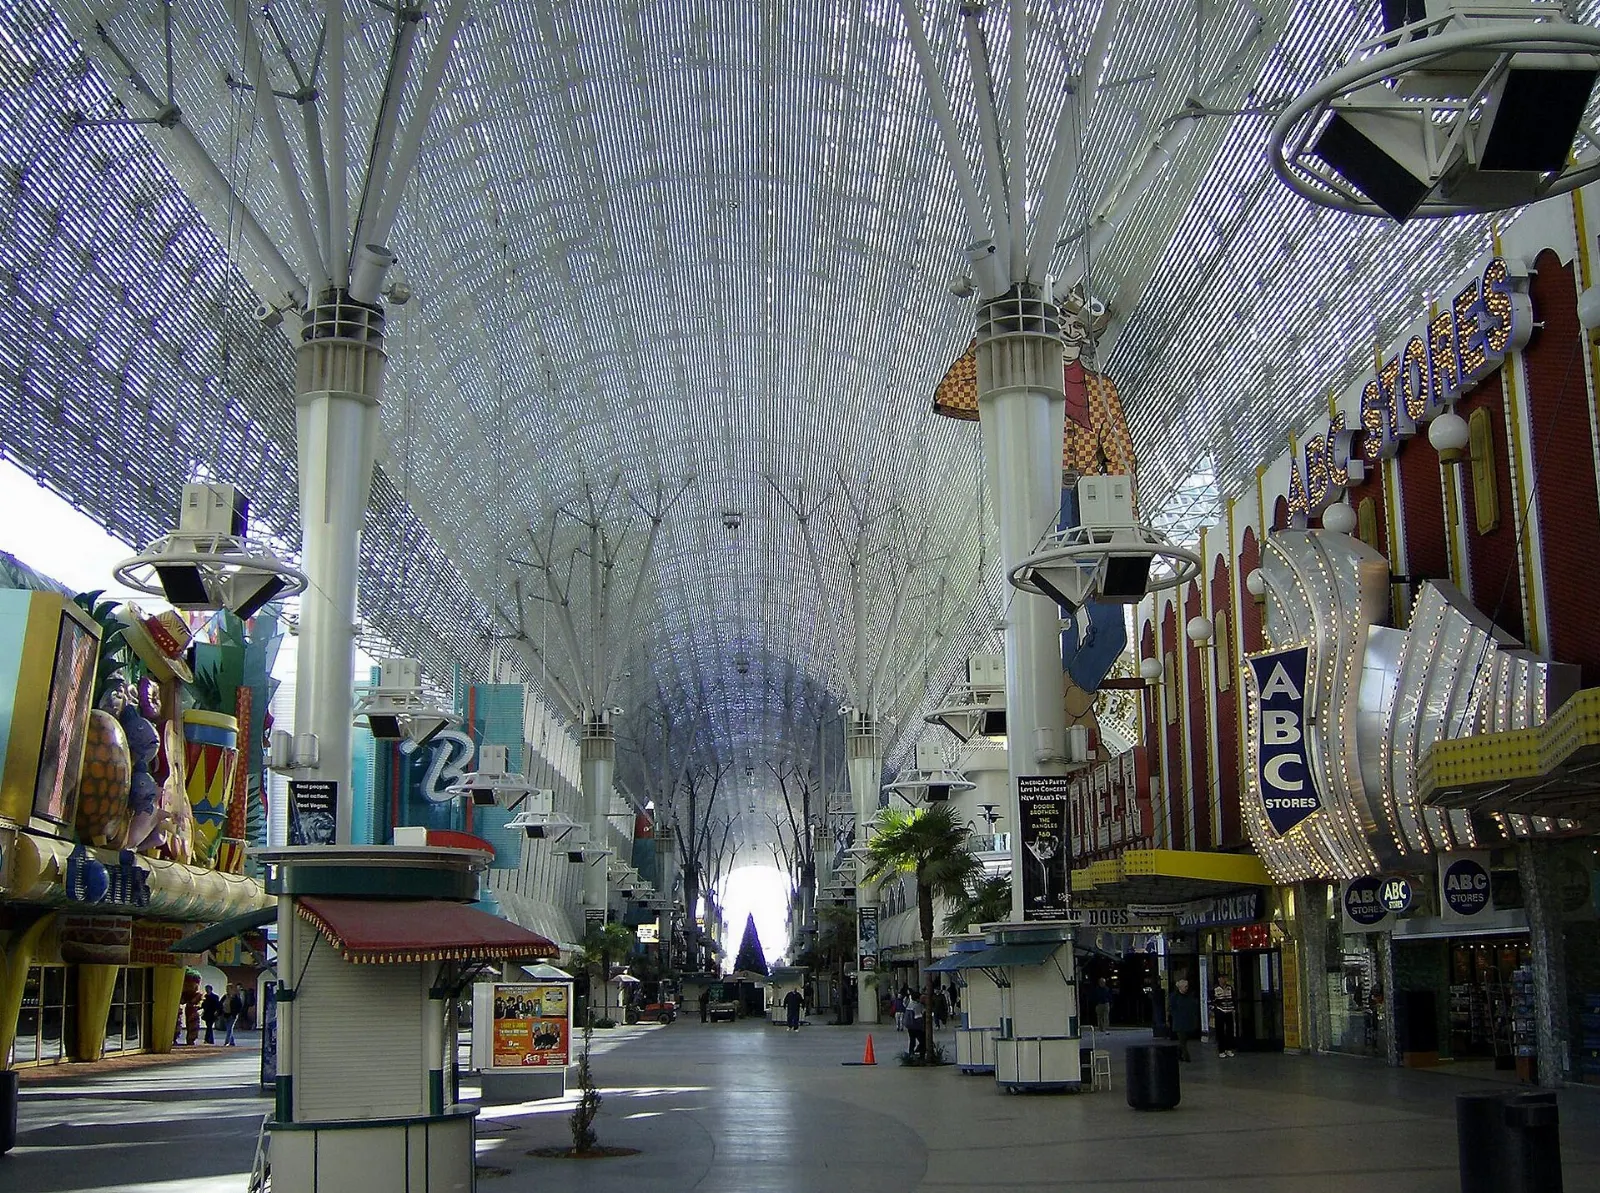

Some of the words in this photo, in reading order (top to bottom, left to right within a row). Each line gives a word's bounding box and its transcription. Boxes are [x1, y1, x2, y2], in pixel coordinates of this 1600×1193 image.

[1286, 409, 1350, 529] ABC
[1360, 256, 1513, 459] STORES
[1260, 660, 1304, 791] ABC
[1265, 798, 1317, 809] STORES
[1446, 873, 1487, 890] ABC
[1384, 880, 1407, 901] ABC
[1450, 892, 1484, 903] STORES
[1212, 893, 1257, 922] TICKETS
[1352, 906, 1385, 915] STORES
[1388, 900, 1403, 909] STORES
[1089, 909, 1129, 926] DOGS
